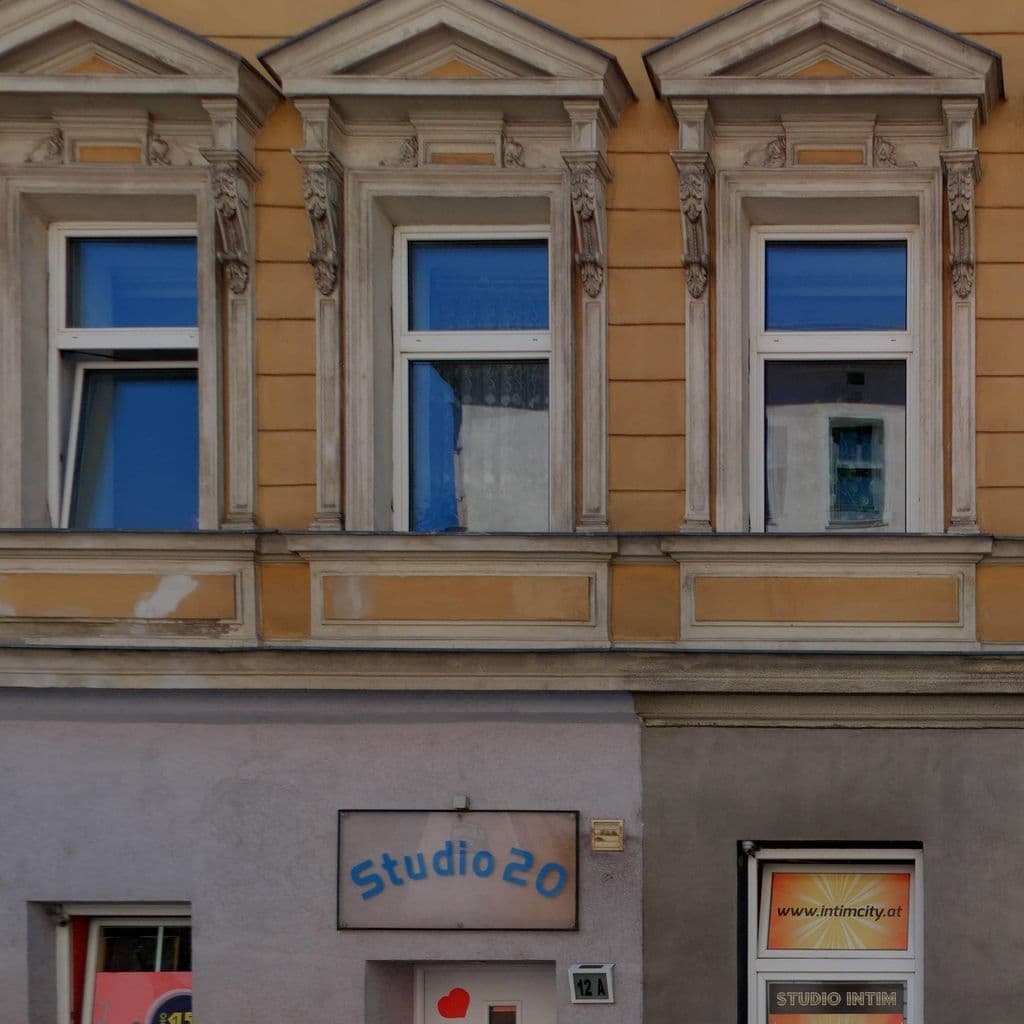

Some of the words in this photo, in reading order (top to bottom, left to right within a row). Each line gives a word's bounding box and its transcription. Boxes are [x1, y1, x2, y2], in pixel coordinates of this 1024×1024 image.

[350, 841, 495, 900] Studio
[503, 847, 569, 898] 20
[777, 905, 904, 921] www.intimcity.at
[577, 978, 593, 996] 12
[597, 977, 606, 996] A
[776, 991, 842, 1007] STUDIO
[846, 991, 897, 1006] INTIM
